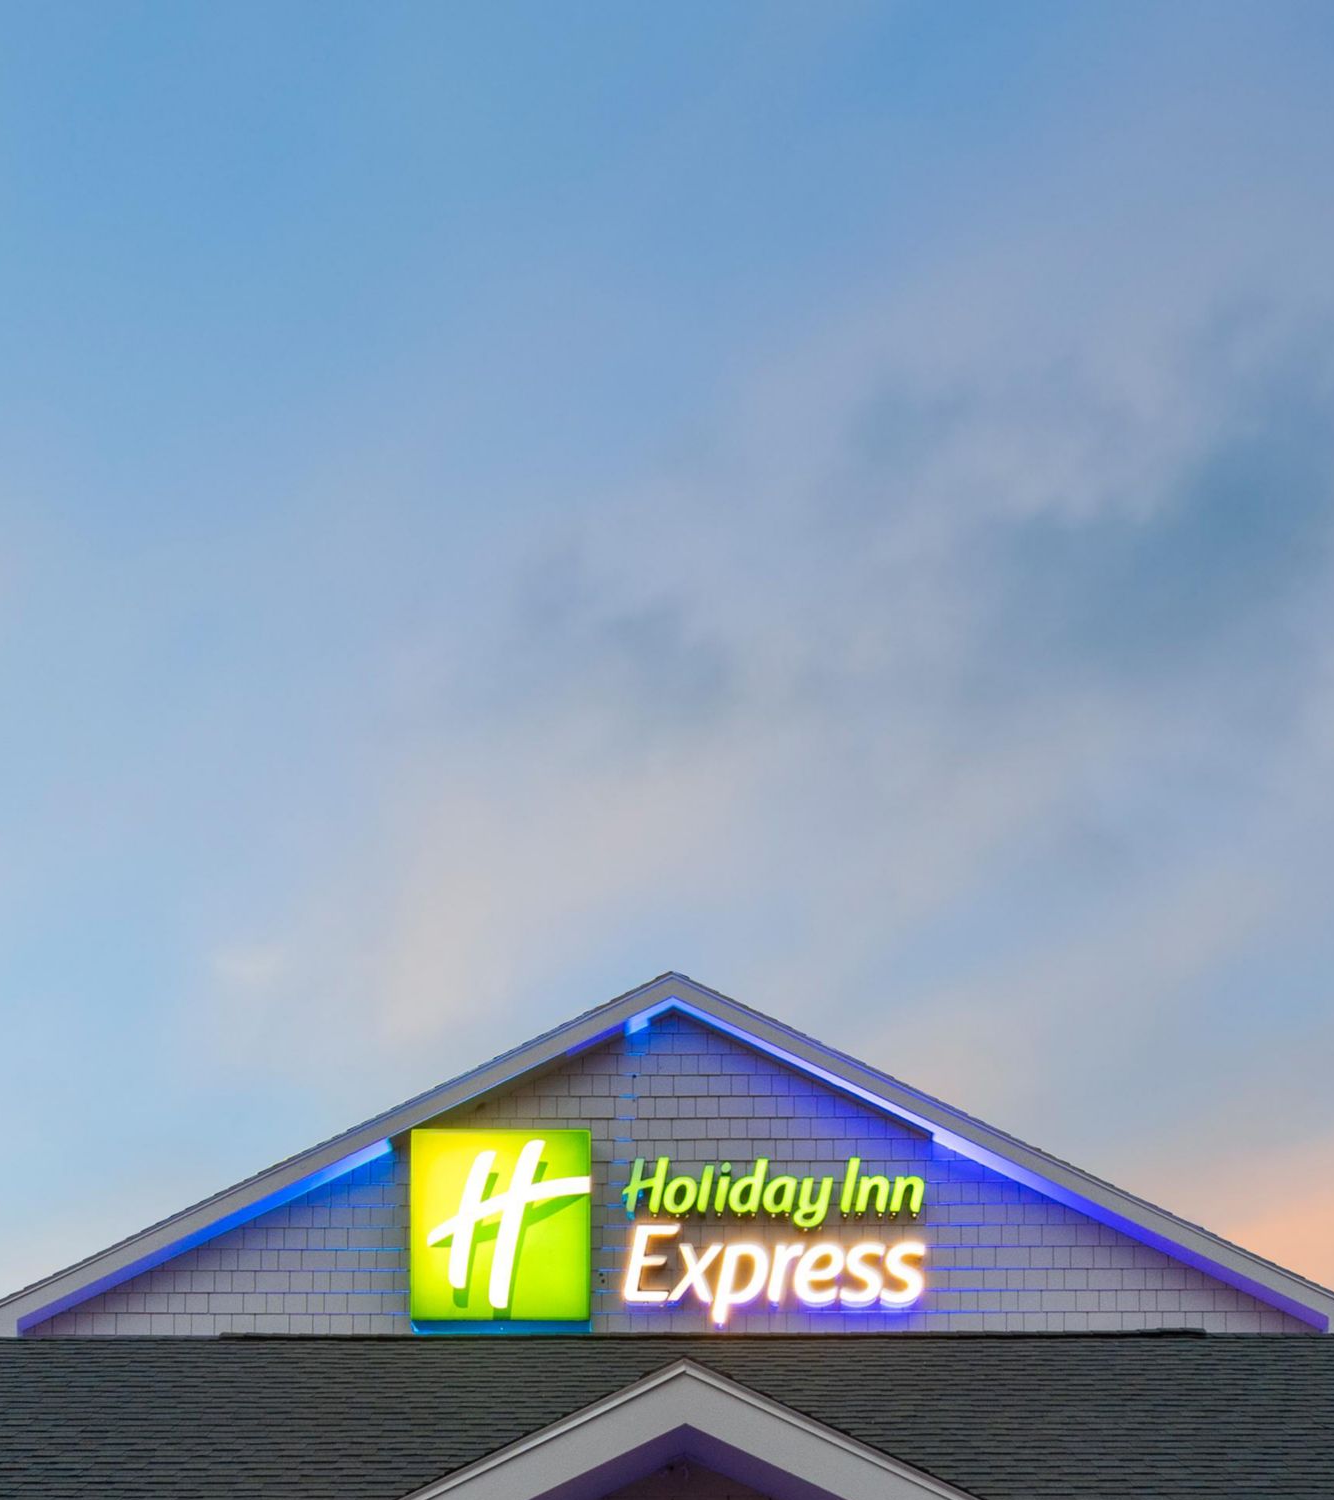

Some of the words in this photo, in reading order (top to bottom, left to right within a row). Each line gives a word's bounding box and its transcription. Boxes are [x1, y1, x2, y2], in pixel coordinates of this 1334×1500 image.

[622, 1156, 832, 1229] Holiday
[841, 1156, 925, 1216] Inn
[622, 1222, 927, 1327] Express
